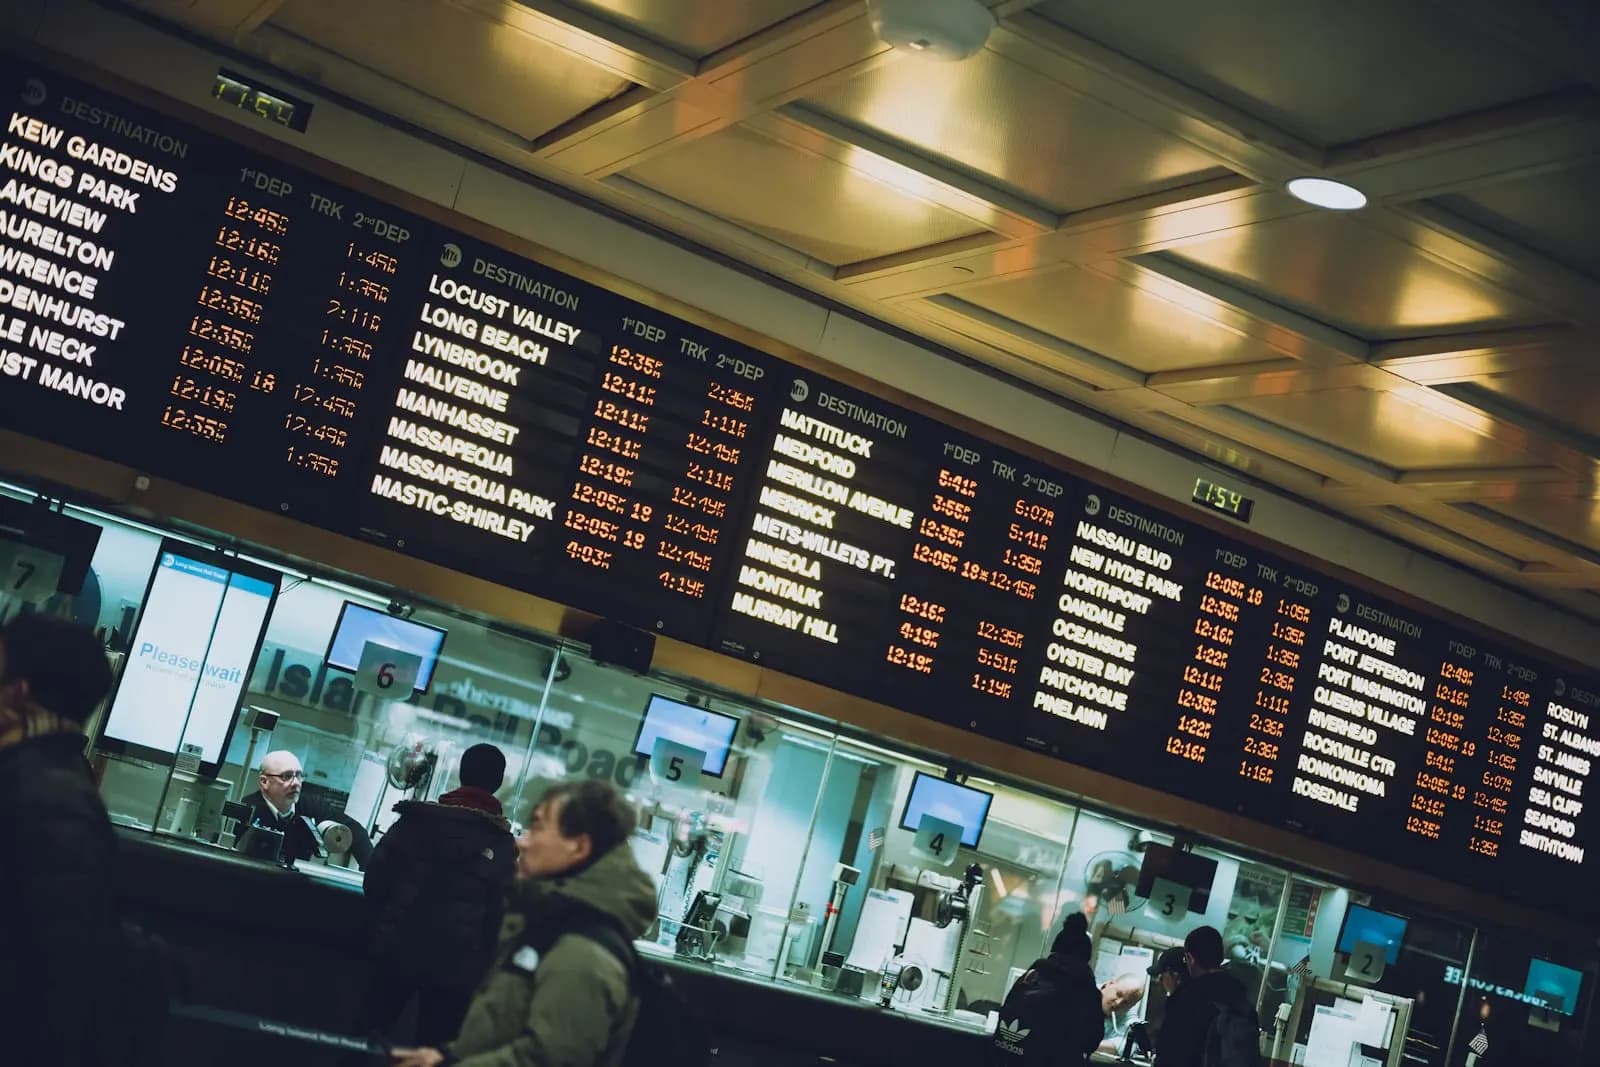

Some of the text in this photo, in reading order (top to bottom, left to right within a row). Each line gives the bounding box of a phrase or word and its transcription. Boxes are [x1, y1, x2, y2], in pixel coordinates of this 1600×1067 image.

[60, 97, 189, 158] DESTINATION
[8, 112, 179, 192] KEW GARDENS
[0, 142, 140, 213] KINGS PARK
[309, 192, 343, 221] TRK
[473, 258, 579, 310] DESTINATION
[428, 274, 581, 345] LOCUST VALLEY
[29, 326, 97, 367] NECK
[421, 303, 549, 365] LONG BEACH
[679, 338, 710, 361] TRK
[412, 331, 521, 386] LYNBROOK
[39, 363, 127, 410] MANOR
[404, 360, 509, 412] MALVERNE
[396, 388, 519, 446] MANHASSET
[781, 408, 874, 458] MATTITUCK
[817, 392, 907, 438] DESTINATION
[388, 417, 514, 477] MASSAPEQUA
[773, 434, 856, 479] MEDFORD
[380, 446, 557, 520] MASSAPEQUA PARK
[991, 460, 1017, 481] TRK
[371, 474, 535, 543] MASTIC-SHIRLEY
[759, 486, 836, 528] MERRICK
[767, 459, 914, 529] MERILLON AVENUE
[752, 513, 896, 579] METS-WILLETS PT.
[1077, 521, 1172, 571] NASSAU BLVD
[1108, 505, 1184, 546] DESTINATION
[15, 560, 36, 590] 7
[746, 539, 821, 581] MINEOLA
[1070, 544, 1184, 602] NEW HYDE PARK
[1257, 564, 1278, 583] TRK
[739, 565, 823, 609] MONTAUK
[1063, 568, 1152, 615] NORTHPORT
[731, 592, 839, 643] MURRAY HILL
[1058, 593, 1126, 632] OAKDALE
[1356, 603, 1422, 639] DESTINATION
[1052, 618, 1137, 662] OCEANSIDE
[1329, 617, 1396, 656] PLANDOME
[140, 642, 200, 671] Please
[204, 664, 241, 683] wait
[377, 662, 396, 688] 6
[1047, 642, 1135, 687] OYSTER BAY
[1323, 640, 1425, 691] PORT JEFFERSON
[1033, 691, 1107, 730] PINELAWN
[1040, 666, 1128, 711] PATCHOGUE
[1314, 686, 1416, 735] QUEENS VILLAGE
[1318, 662, 1426, 715] PORT WASHINGTON
[1308, 708, 1377, 745] RIVERHEAD
[1546, 702, 1589, 730] ROSLYN
[1303, 731, 1397, 777] ROCKVILLE CTR
[1555, 753, 1591, 776] JAMES
[1560, 732, 1600, 757] ALBANS
[666, 757, 684, 782] 5
[1298, 754, 1386, 797] RONKONKOMA
[1533, 766, 1584, 796] SAYVILLE
[1292, 776, 1359, 812] ROSEDALE
[1528, 787, 1583, 817] SEA CLIFF
[929, 833, 945, 856] 4
[1524, 808, 1575, 838] SEAFORD
[1519, 829, 1585, 863] SMITHTOWN
[1162, 894, 1176, 916] 3
[1361, 954, 1374, 975] 2
